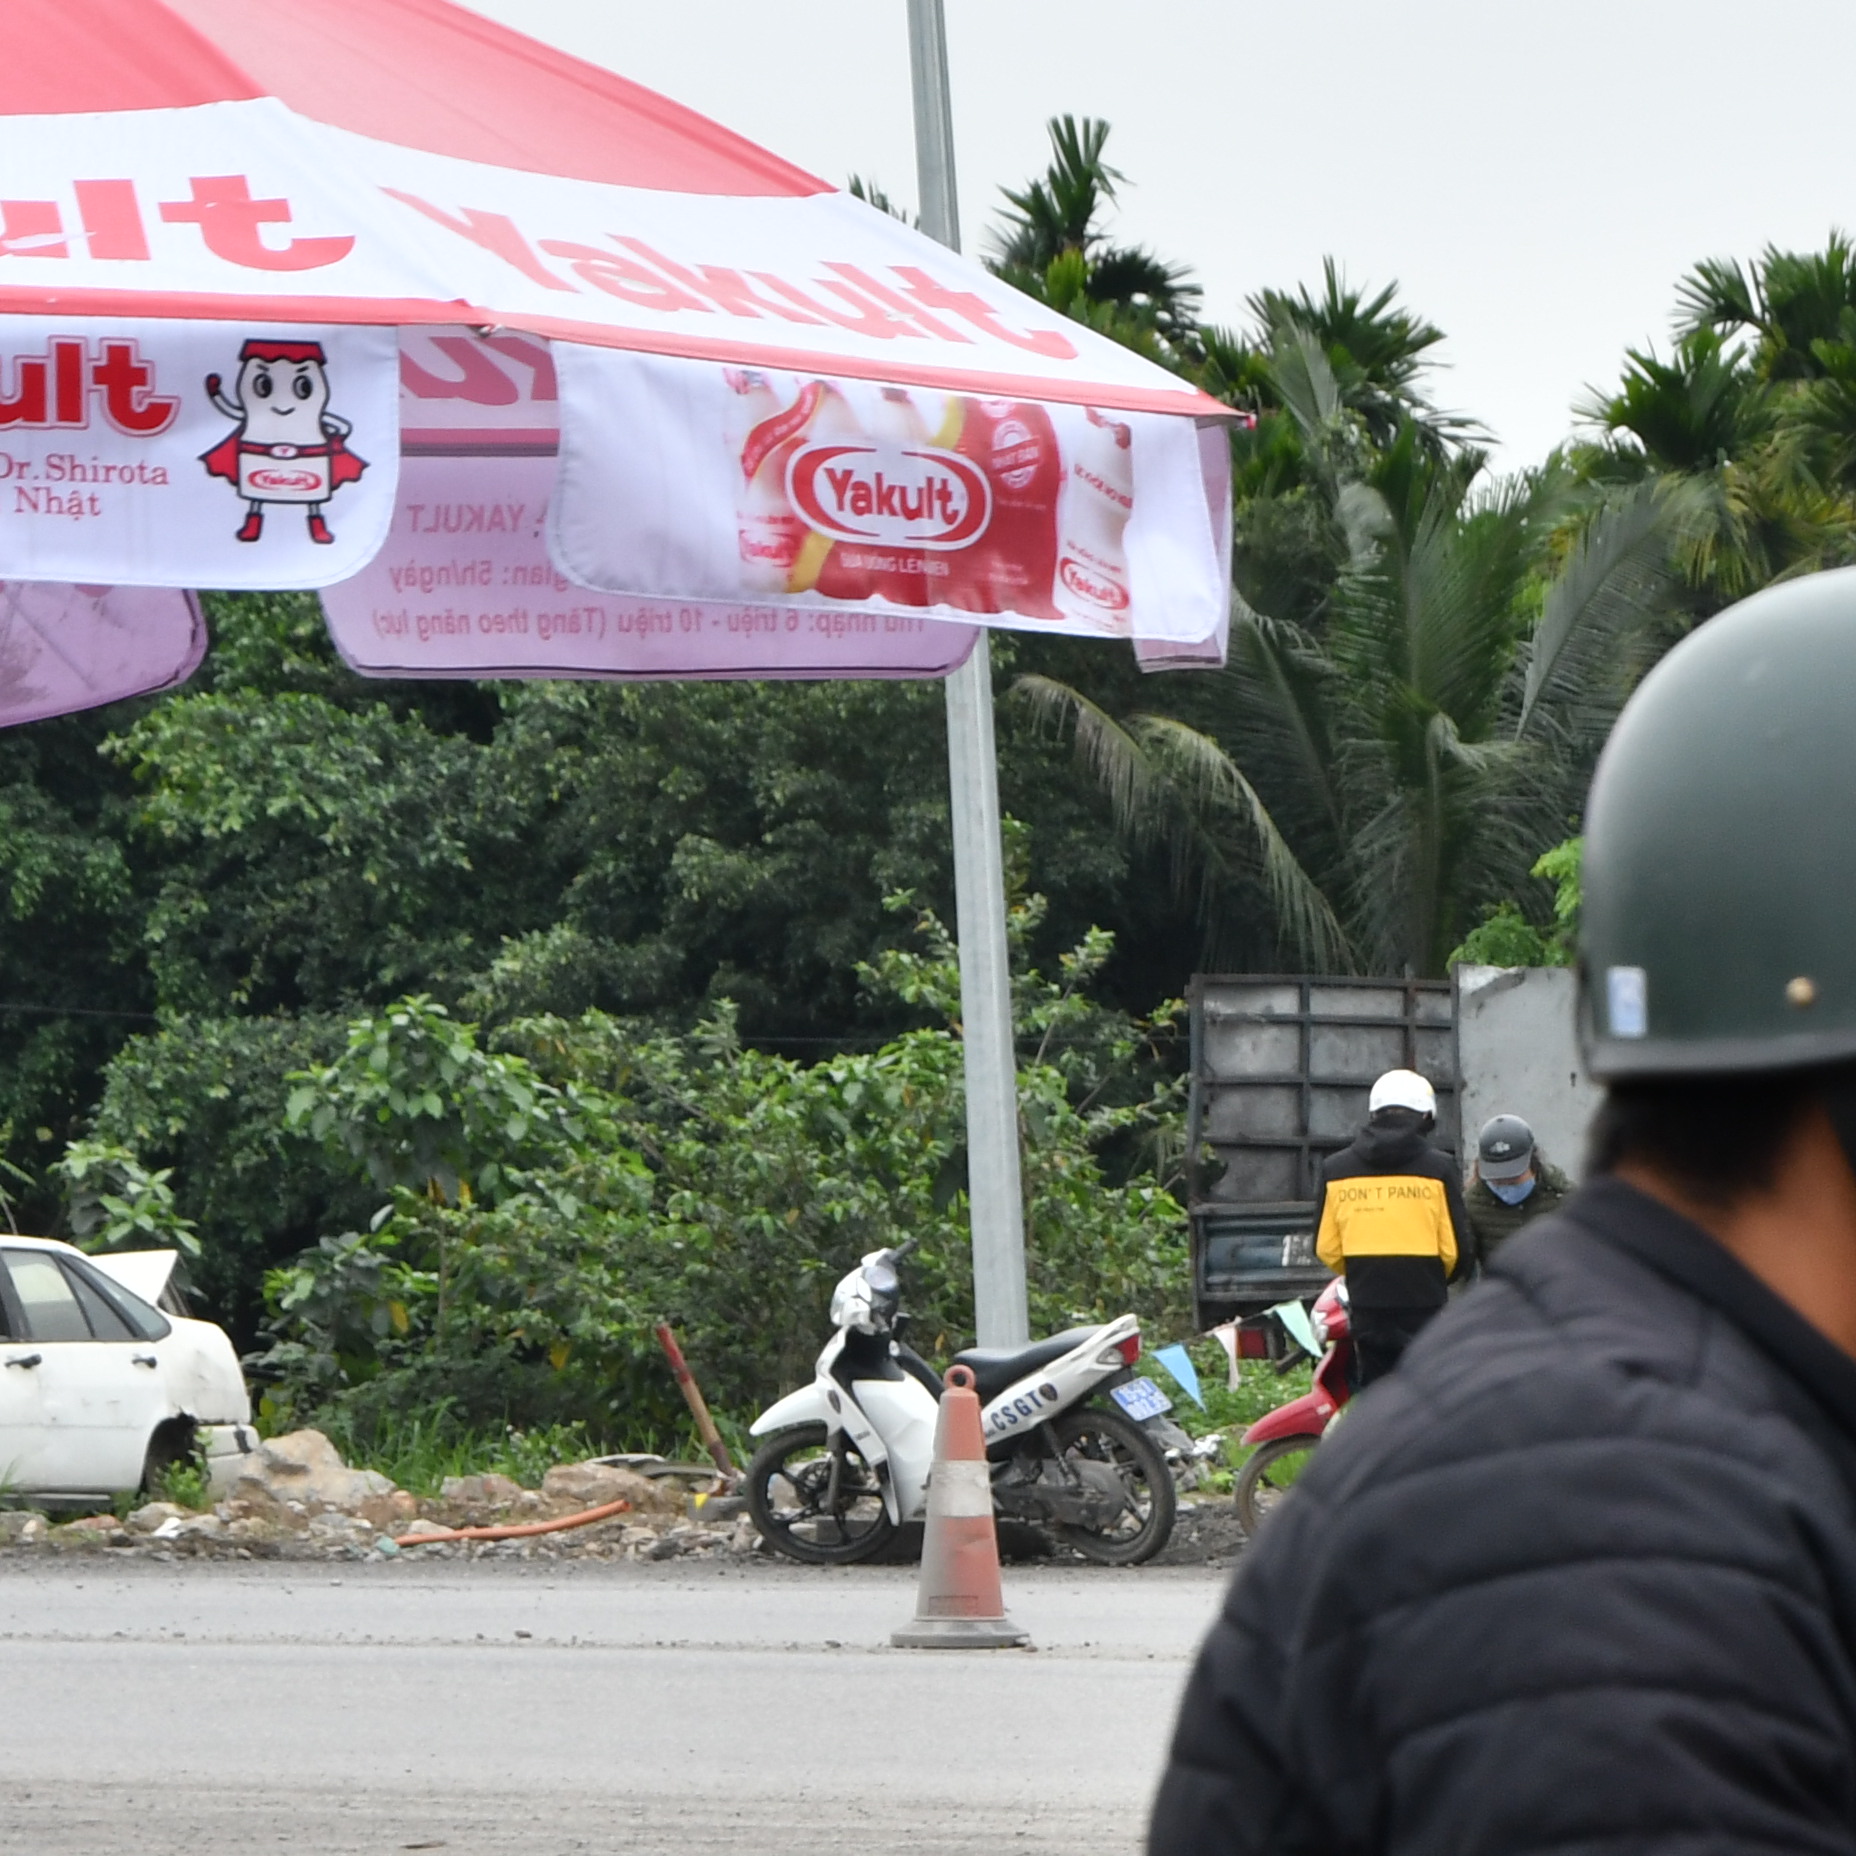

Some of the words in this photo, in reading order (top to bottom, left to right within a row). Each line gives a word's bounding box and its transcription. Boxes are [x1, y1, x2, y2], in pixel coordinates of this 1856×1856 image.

[378, 185, 1078, 361] Yakult
[14, 486, 101, 521] Nhật
[823, 468, 958, 525] Yakult
[1388, 1186, 1432, 1199] PANIC
[990, 1390, 1043, 1431] CSGT
